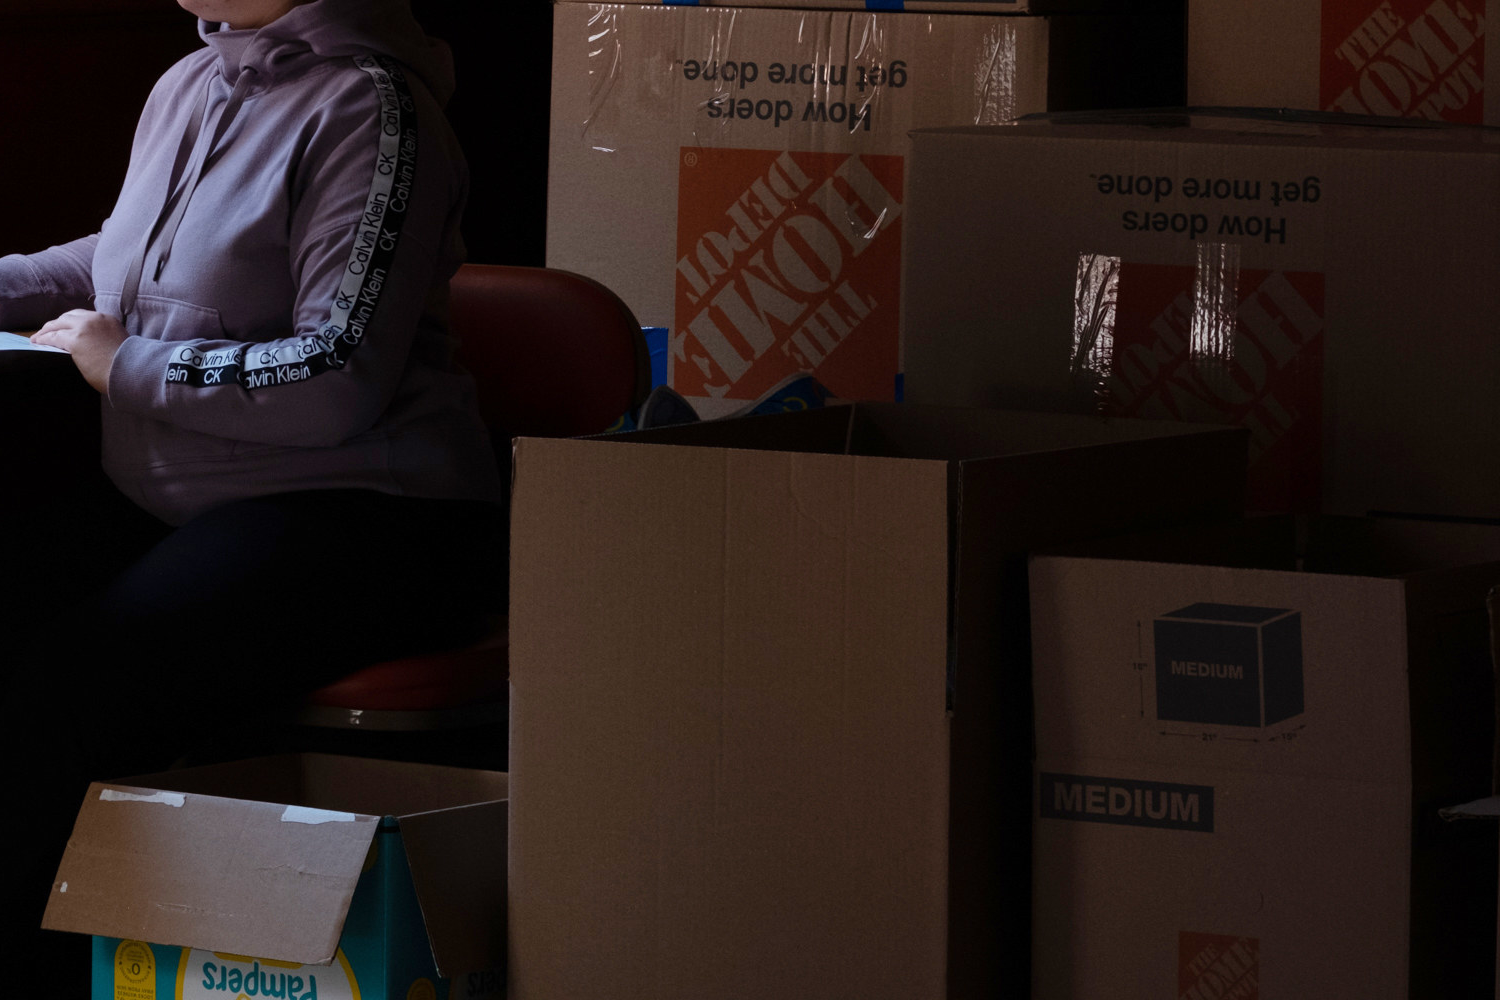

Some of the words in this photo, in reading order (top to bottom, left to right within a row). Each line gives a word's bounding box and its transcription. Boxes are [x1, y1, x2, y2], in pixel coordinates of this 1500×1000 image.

[1335, 0, 1407, 73] THE
[767, 63, 847, 88] more
[855, 60, 908, 93] get
[383, 95, 399, 137] Calvin
[707, 99, 793, 128] doers
[801, 102, 872, 132] How
[400, 128, 418, 166] Klein
[378, 152, 396, 176] CK
[390, 165, 414, 213] Calvin
[1182, 177, 1261, 202] more
[1272, 177, 1321, 206] get
[363, 193, 388, 229] Klein
[1122, 208, 1208, 240] doers
[379, 227, 399, 252] CK
[675, 149, 814, 307] DEPOT
[1220, 216, 1286, 243] How
[348, 230, 376, 275] Calvin
[359, 267, 387, 306] Klein
[674, 153, 902, 397] HOME
[336, 290, 355, 310] CK
[343, 306, 373, 345] Calvin
[781, 281, 879, 372] THE
[180, 347, 222, 367] Calvin
[260, 349, 279, 365] CK
[167, 365, 189, 382] ein
[203, 368, 224, 385] CK
[236, 371, 275, 390] Calvin
[276, 365, 312, 384] Klein
[1171, 660, 1244, 680] MEDIUM
[1053, 782, 1201, 824] MEDIUM
[1187, 943, 1221, 977] THE
[202, 962, 318, 1000] Pampers
